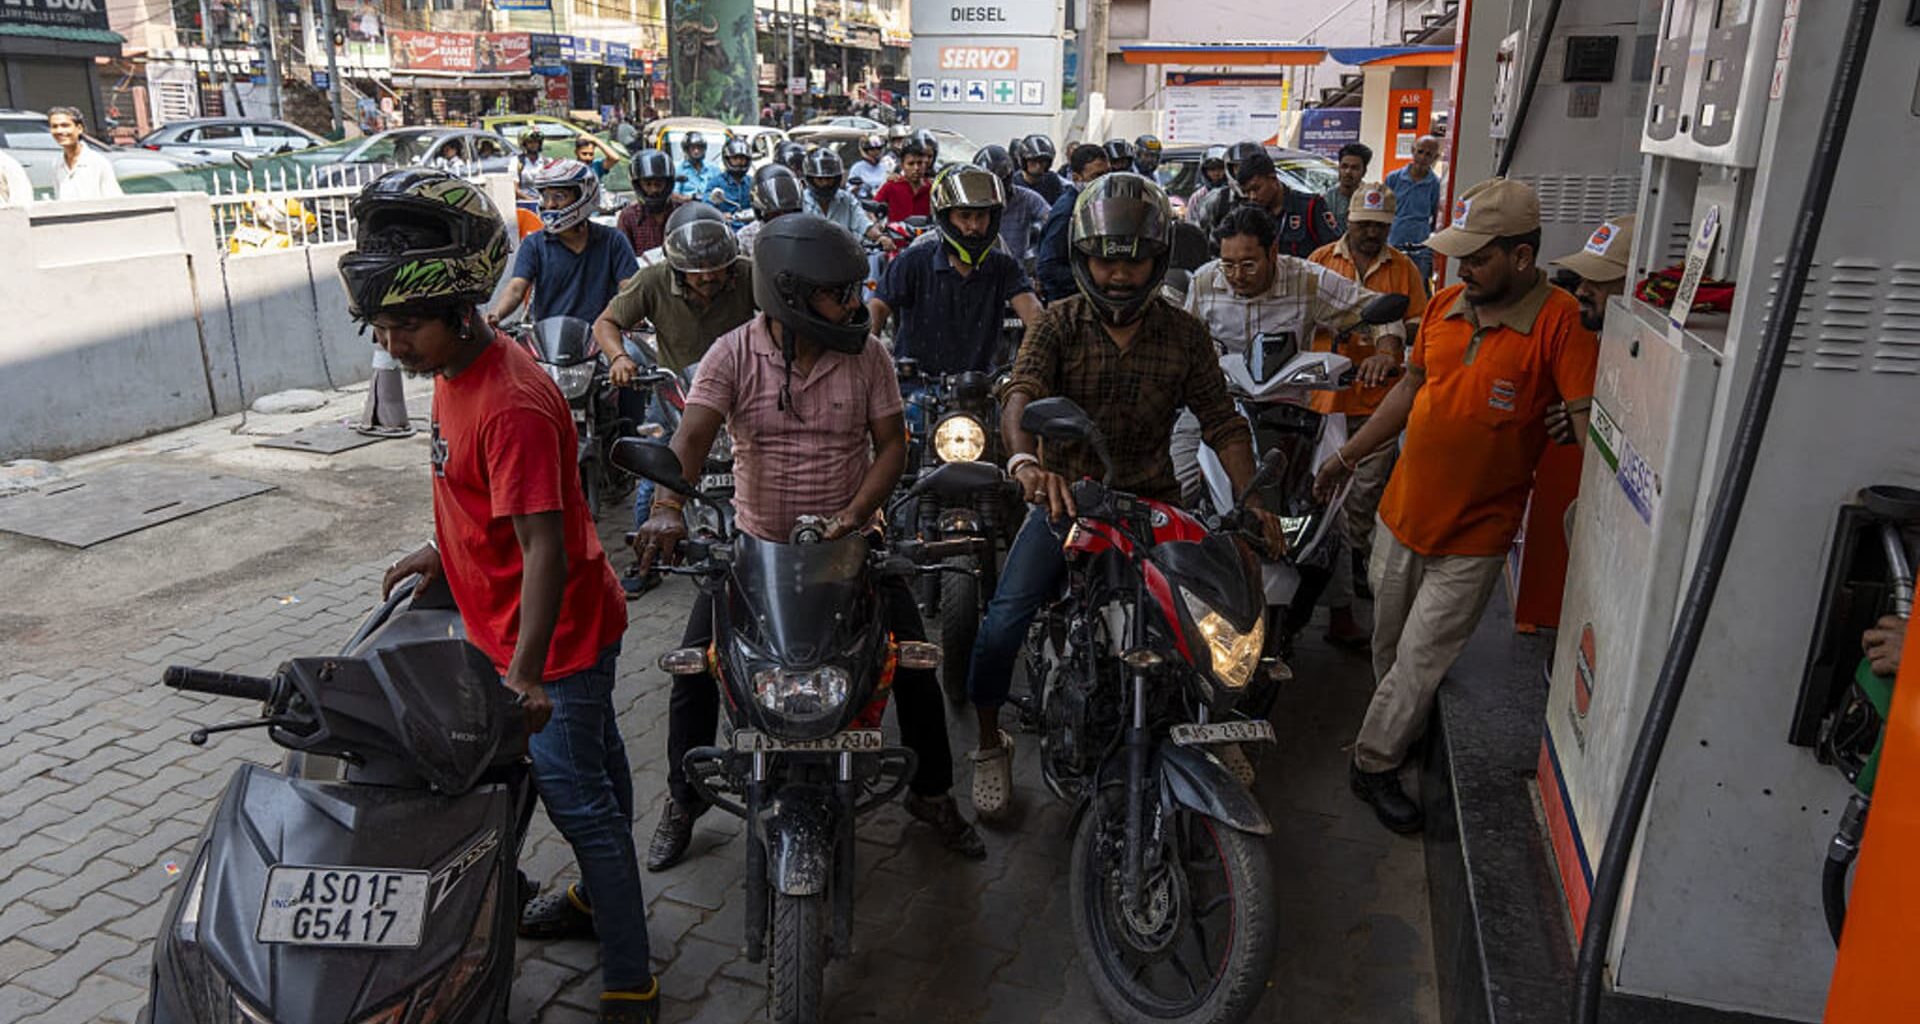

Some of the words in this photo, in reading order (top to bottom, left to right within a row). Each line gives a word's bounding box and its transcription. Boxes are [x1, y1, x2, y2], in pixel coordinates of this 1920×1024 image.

[951, 7, 1006, 21] DIESEL
[442, 57, 472, 67] STORE
[942, 48, 1010, 68] SERVO
[1400, 94, 1421, 104] AIR
[301, 872, 400, 906] AS01F
[293, 908, 397, 943] G5417
